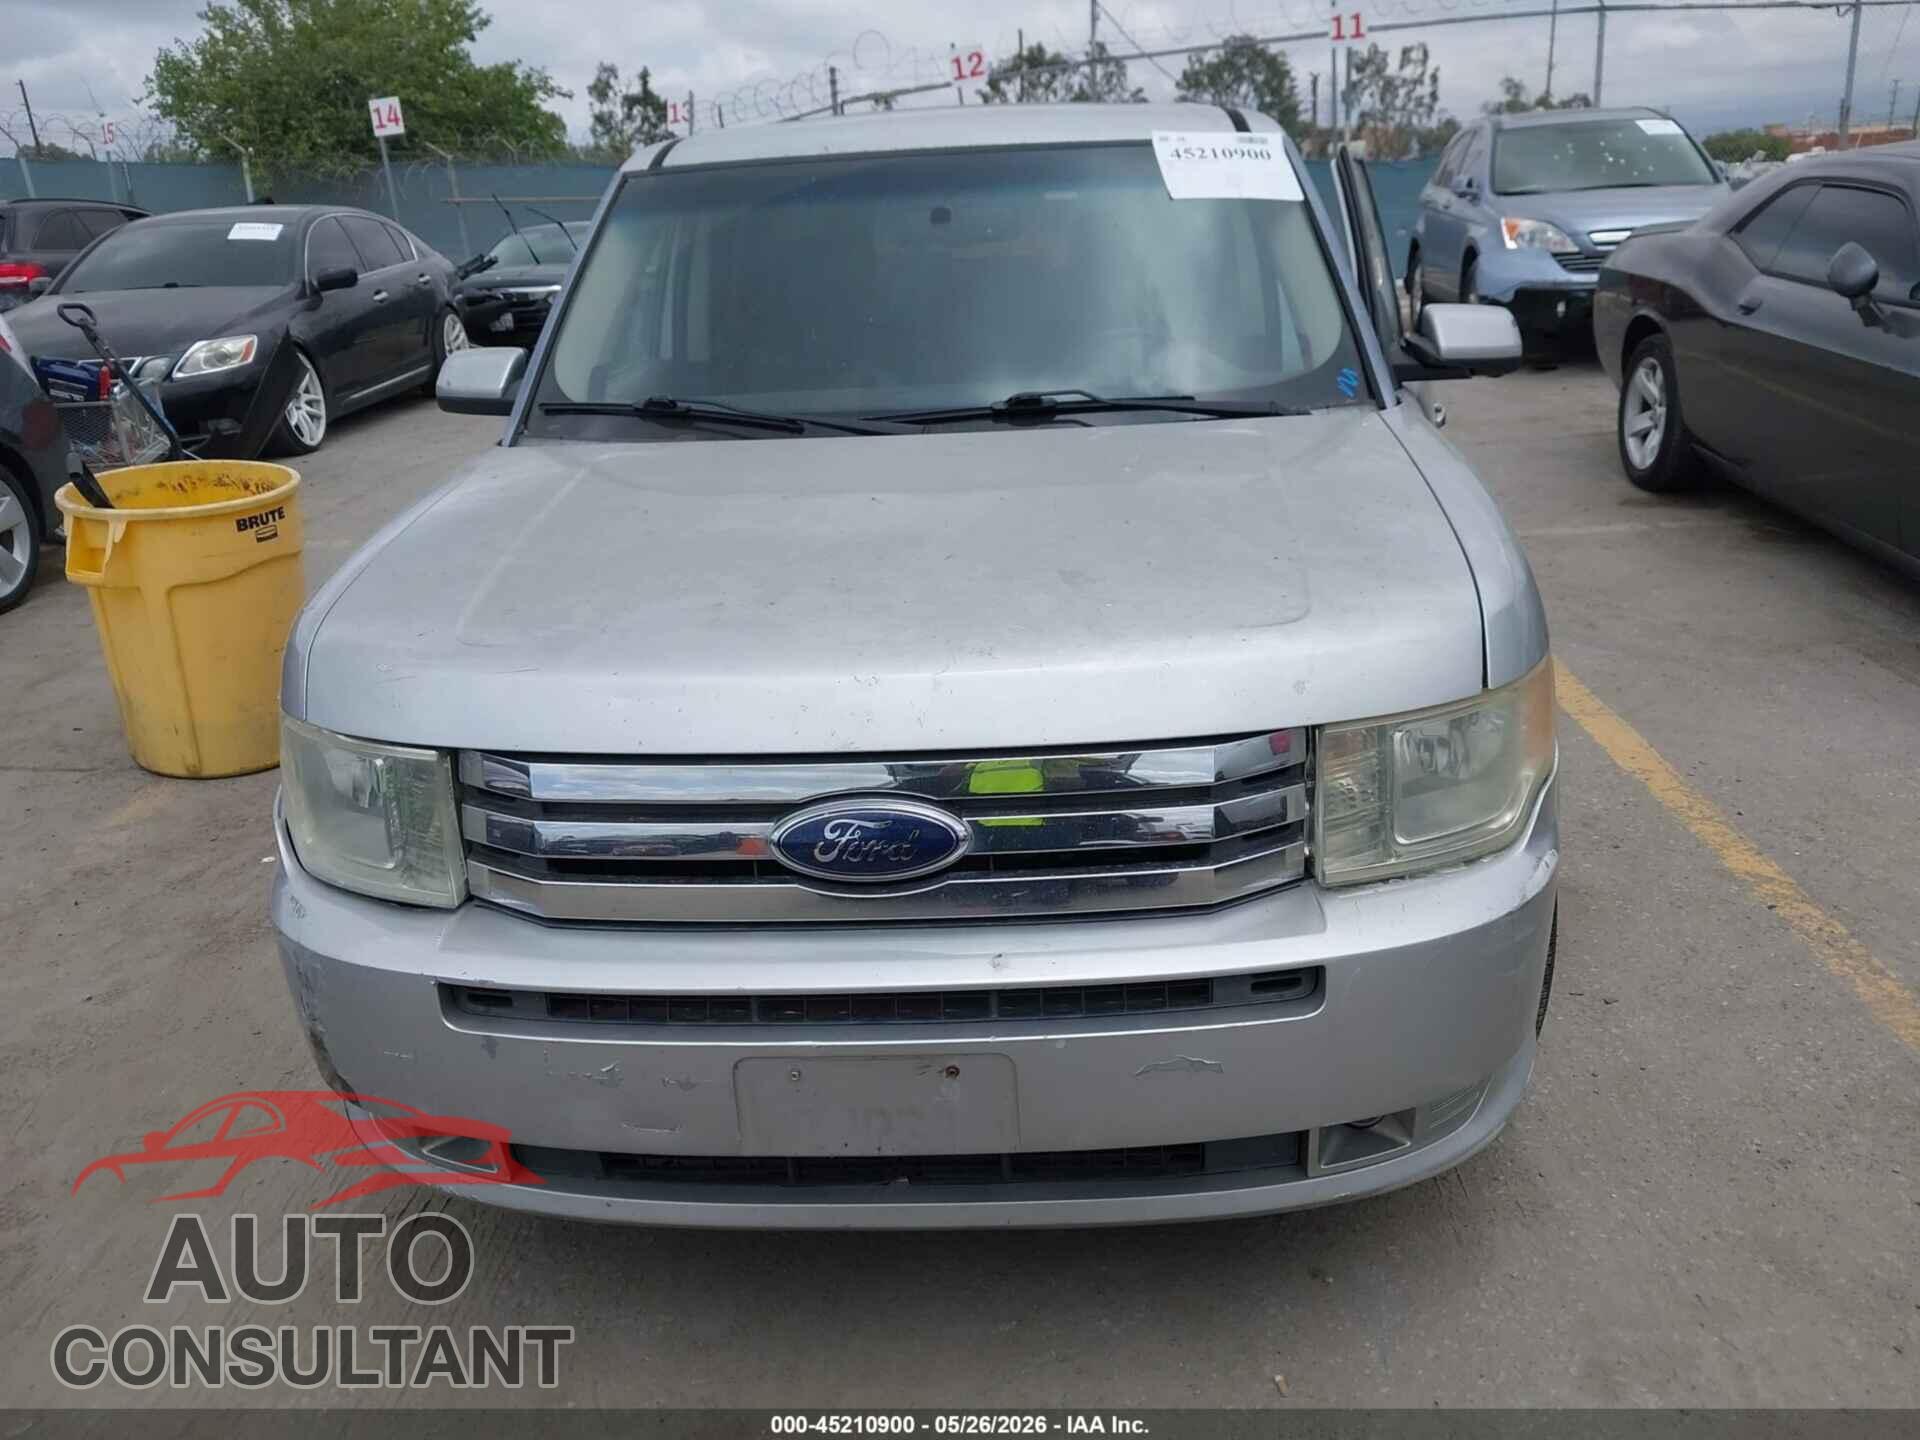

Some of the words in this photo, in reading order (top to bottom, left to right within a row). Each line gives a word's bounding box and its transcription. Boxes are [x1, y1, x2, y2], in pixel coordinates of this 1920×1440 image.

[1331, 13, 1366, 40] 11
[951, 52, 985, 80] 12
[373, 103, 401, 129] 14
[102, 122, 113, 145] 15
[1170, 147, 1272, 161] 45210900
[235, 506, 286, 532] BRUTE
[813, 818, 920, 863] Ford
